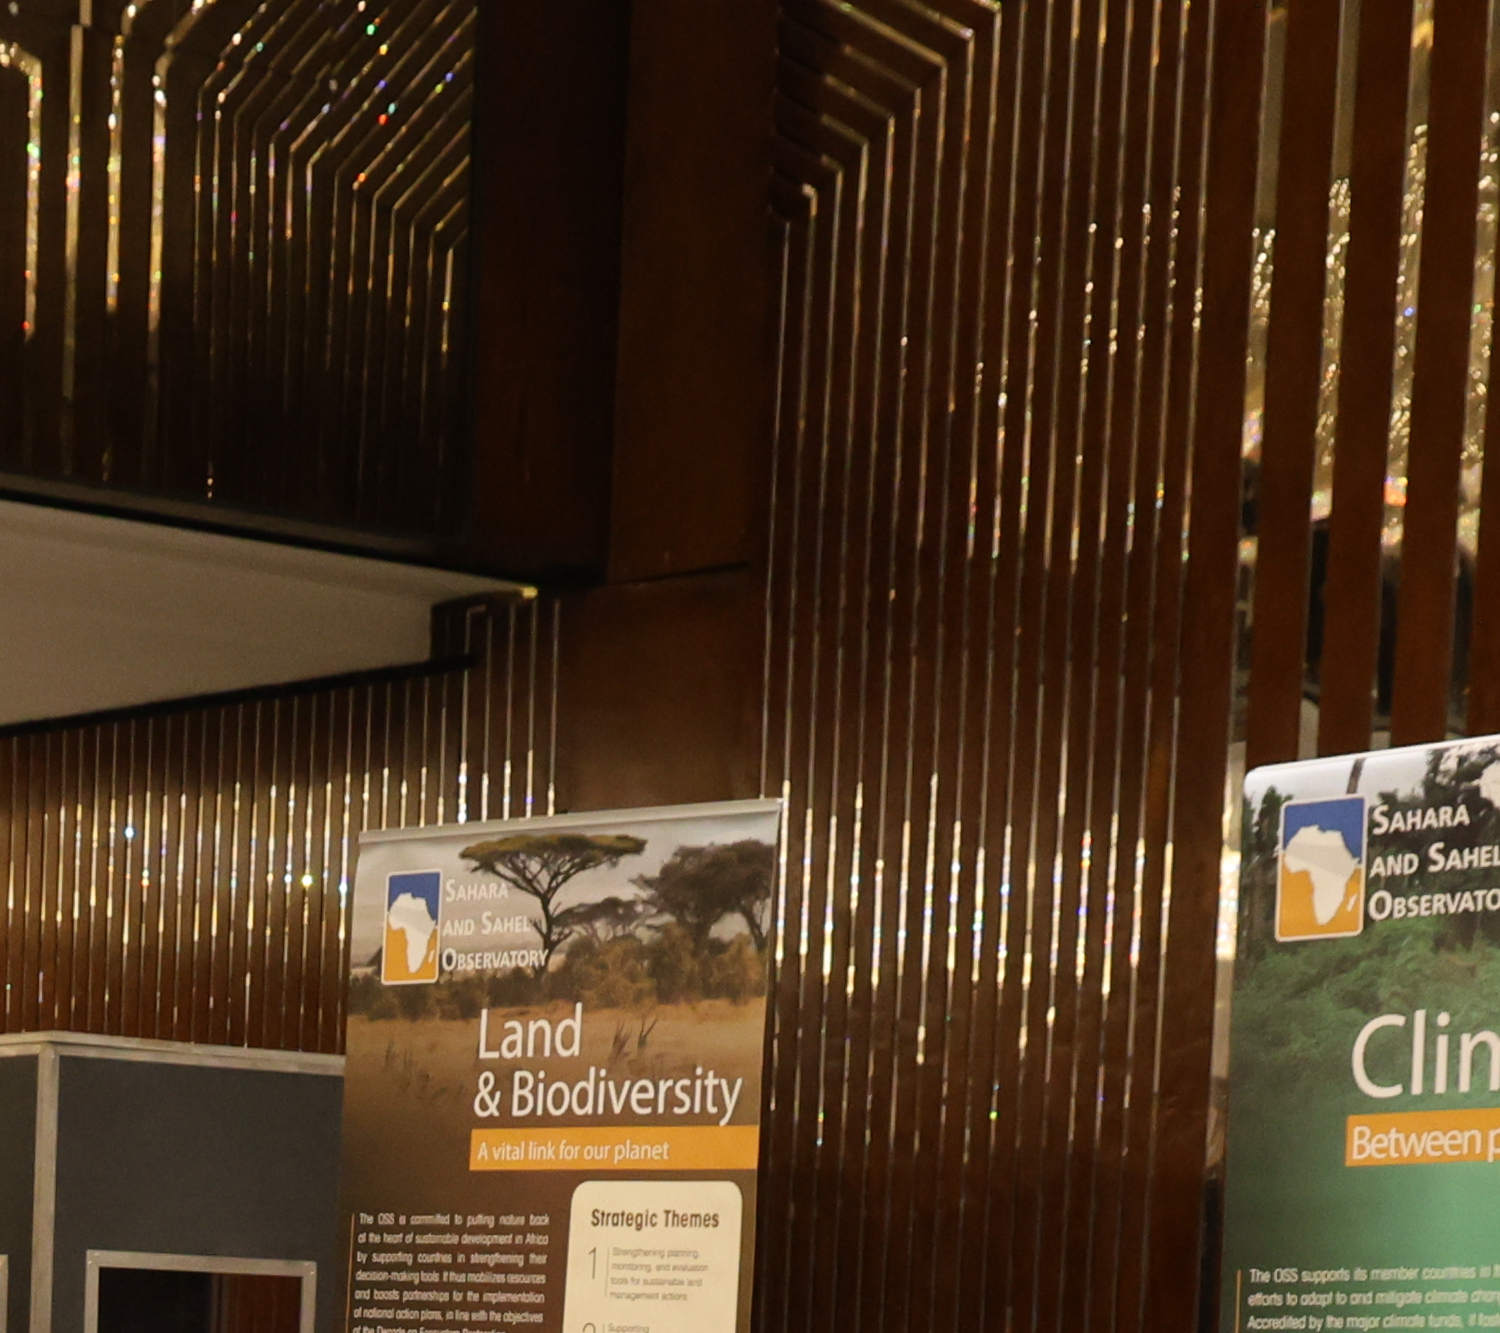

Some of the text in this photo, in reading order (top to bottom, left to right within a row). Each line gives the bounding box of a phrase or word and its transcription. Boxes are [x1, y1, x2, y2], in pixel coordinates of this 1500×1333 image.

[1371, 804, 1470, 835] SAHARA
[1370, 852, 1418, 878] AND
[445, 878, 509, 902] SAHARA
[442, 910, 530, 937] AND SAHEL
[442, 947, 549, 971] OBSERVATORY
[478, 1001, 584, 1060] Land
[473, 1066, 743, 1127] & Biodiversity
[477, 1140, 669, 1164] A vital link for our planet
[1352, 1122, 1481, 1161] Between
[591, 1209, 719, 1231] Strategic Themes
[588, 1247, 597, 1279] 1
